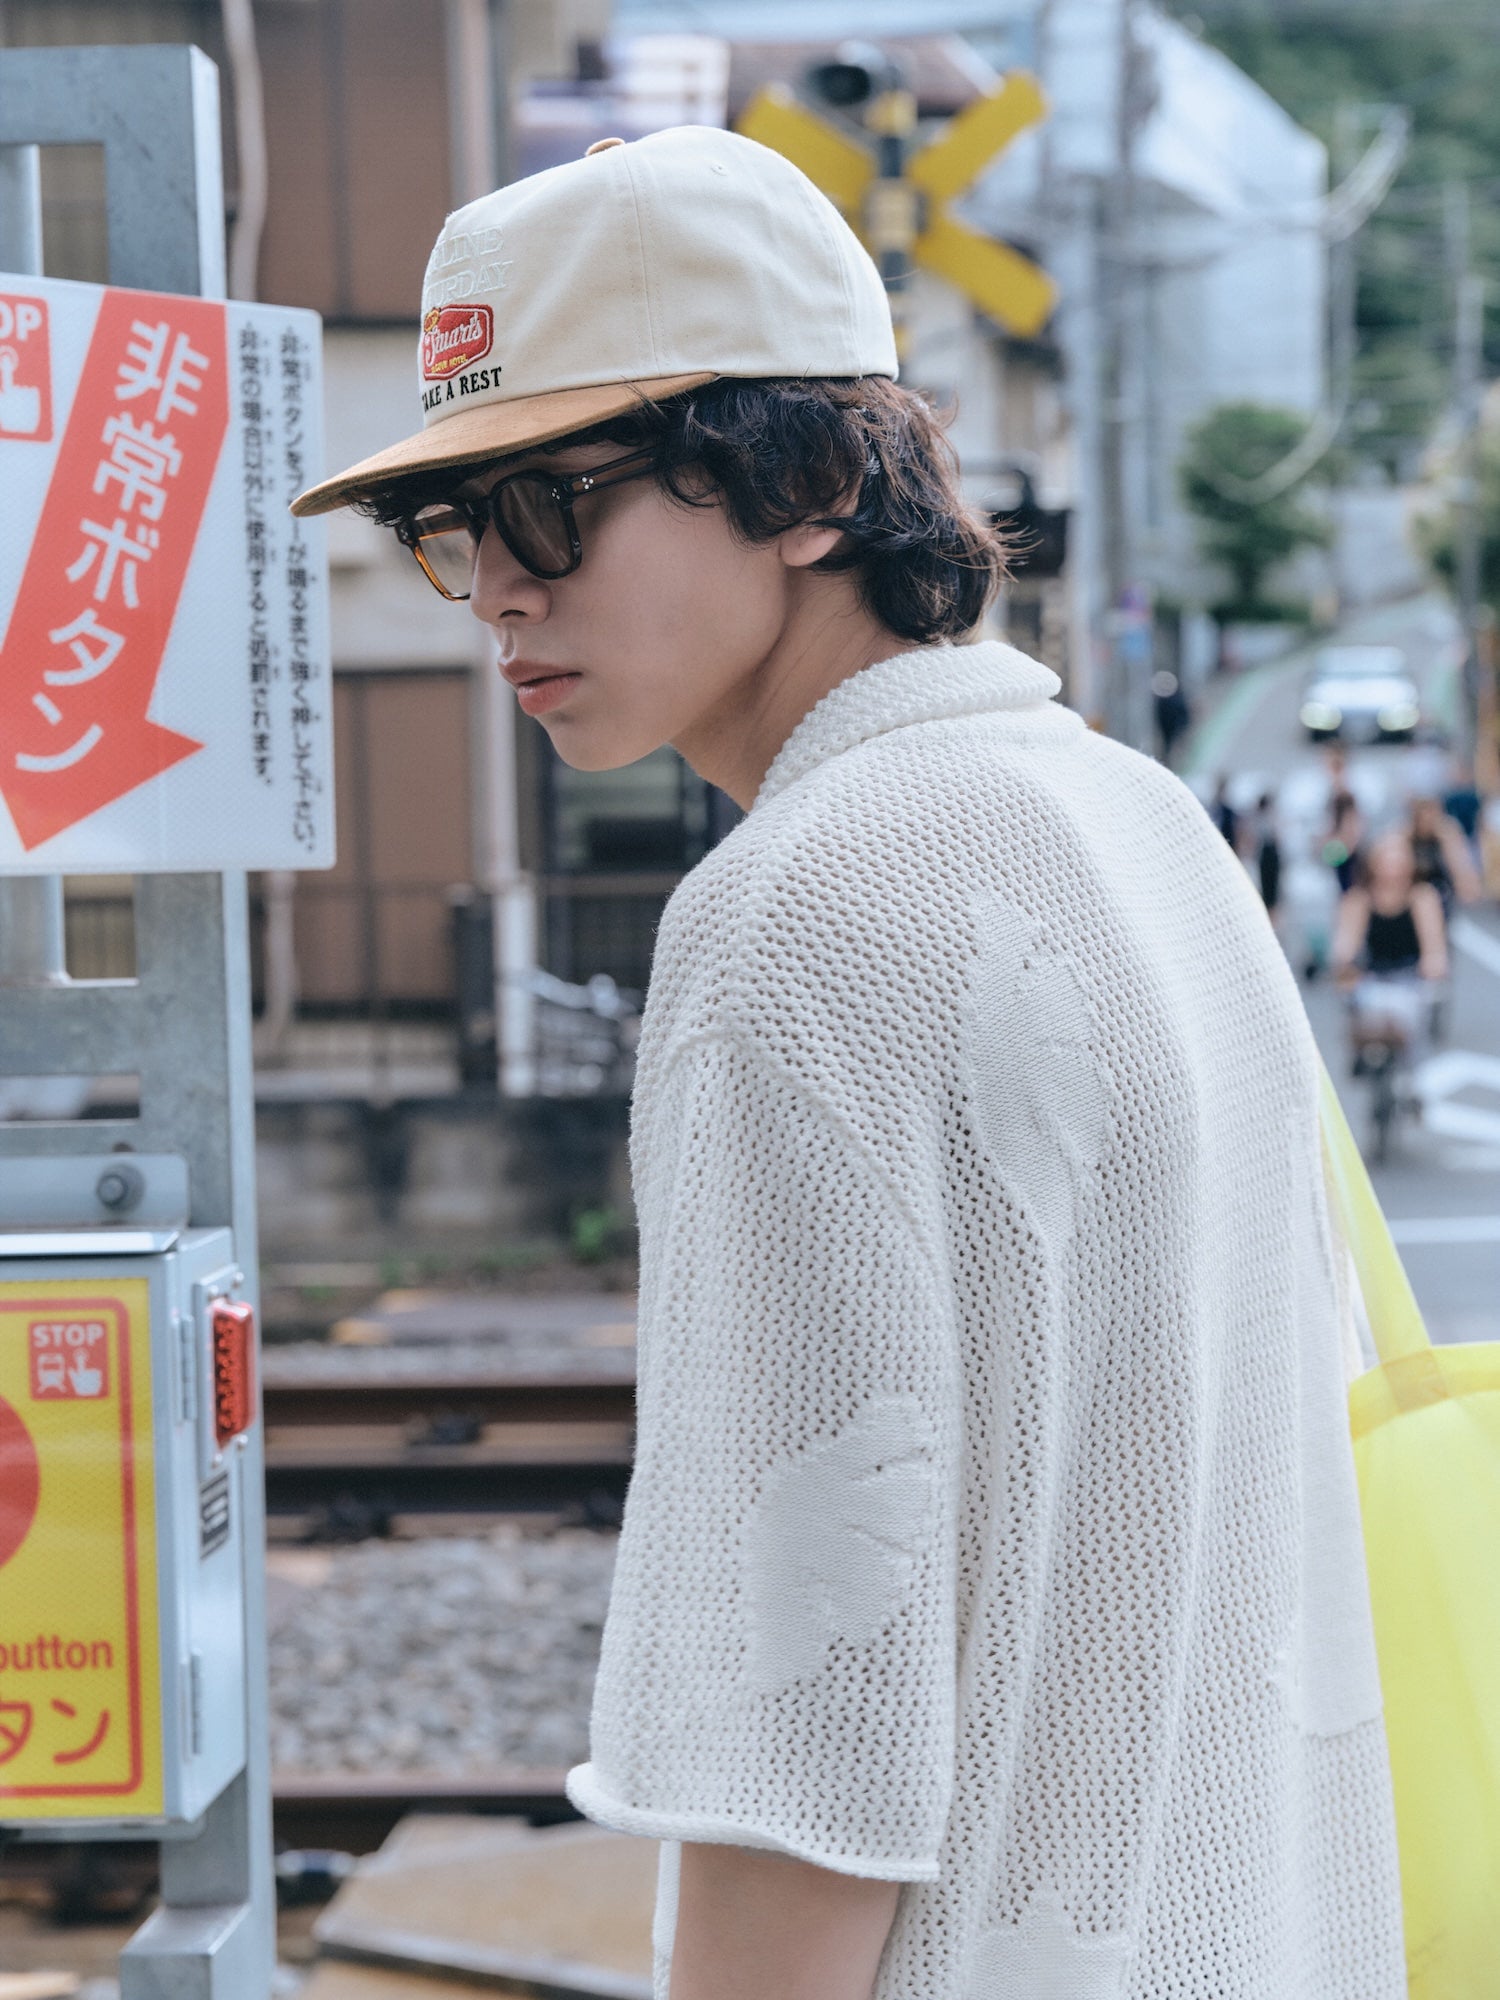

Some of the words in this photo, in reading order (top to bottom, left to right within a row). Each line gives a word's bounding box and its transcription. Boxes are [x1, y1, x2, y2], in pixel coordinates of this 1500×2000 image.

[446, 381, 454, 401] A
[459, 366, 502, 396] REST
[14, 319, 211, 773] 非常ボタン
[33, 1323, 104, 1348] STOP
